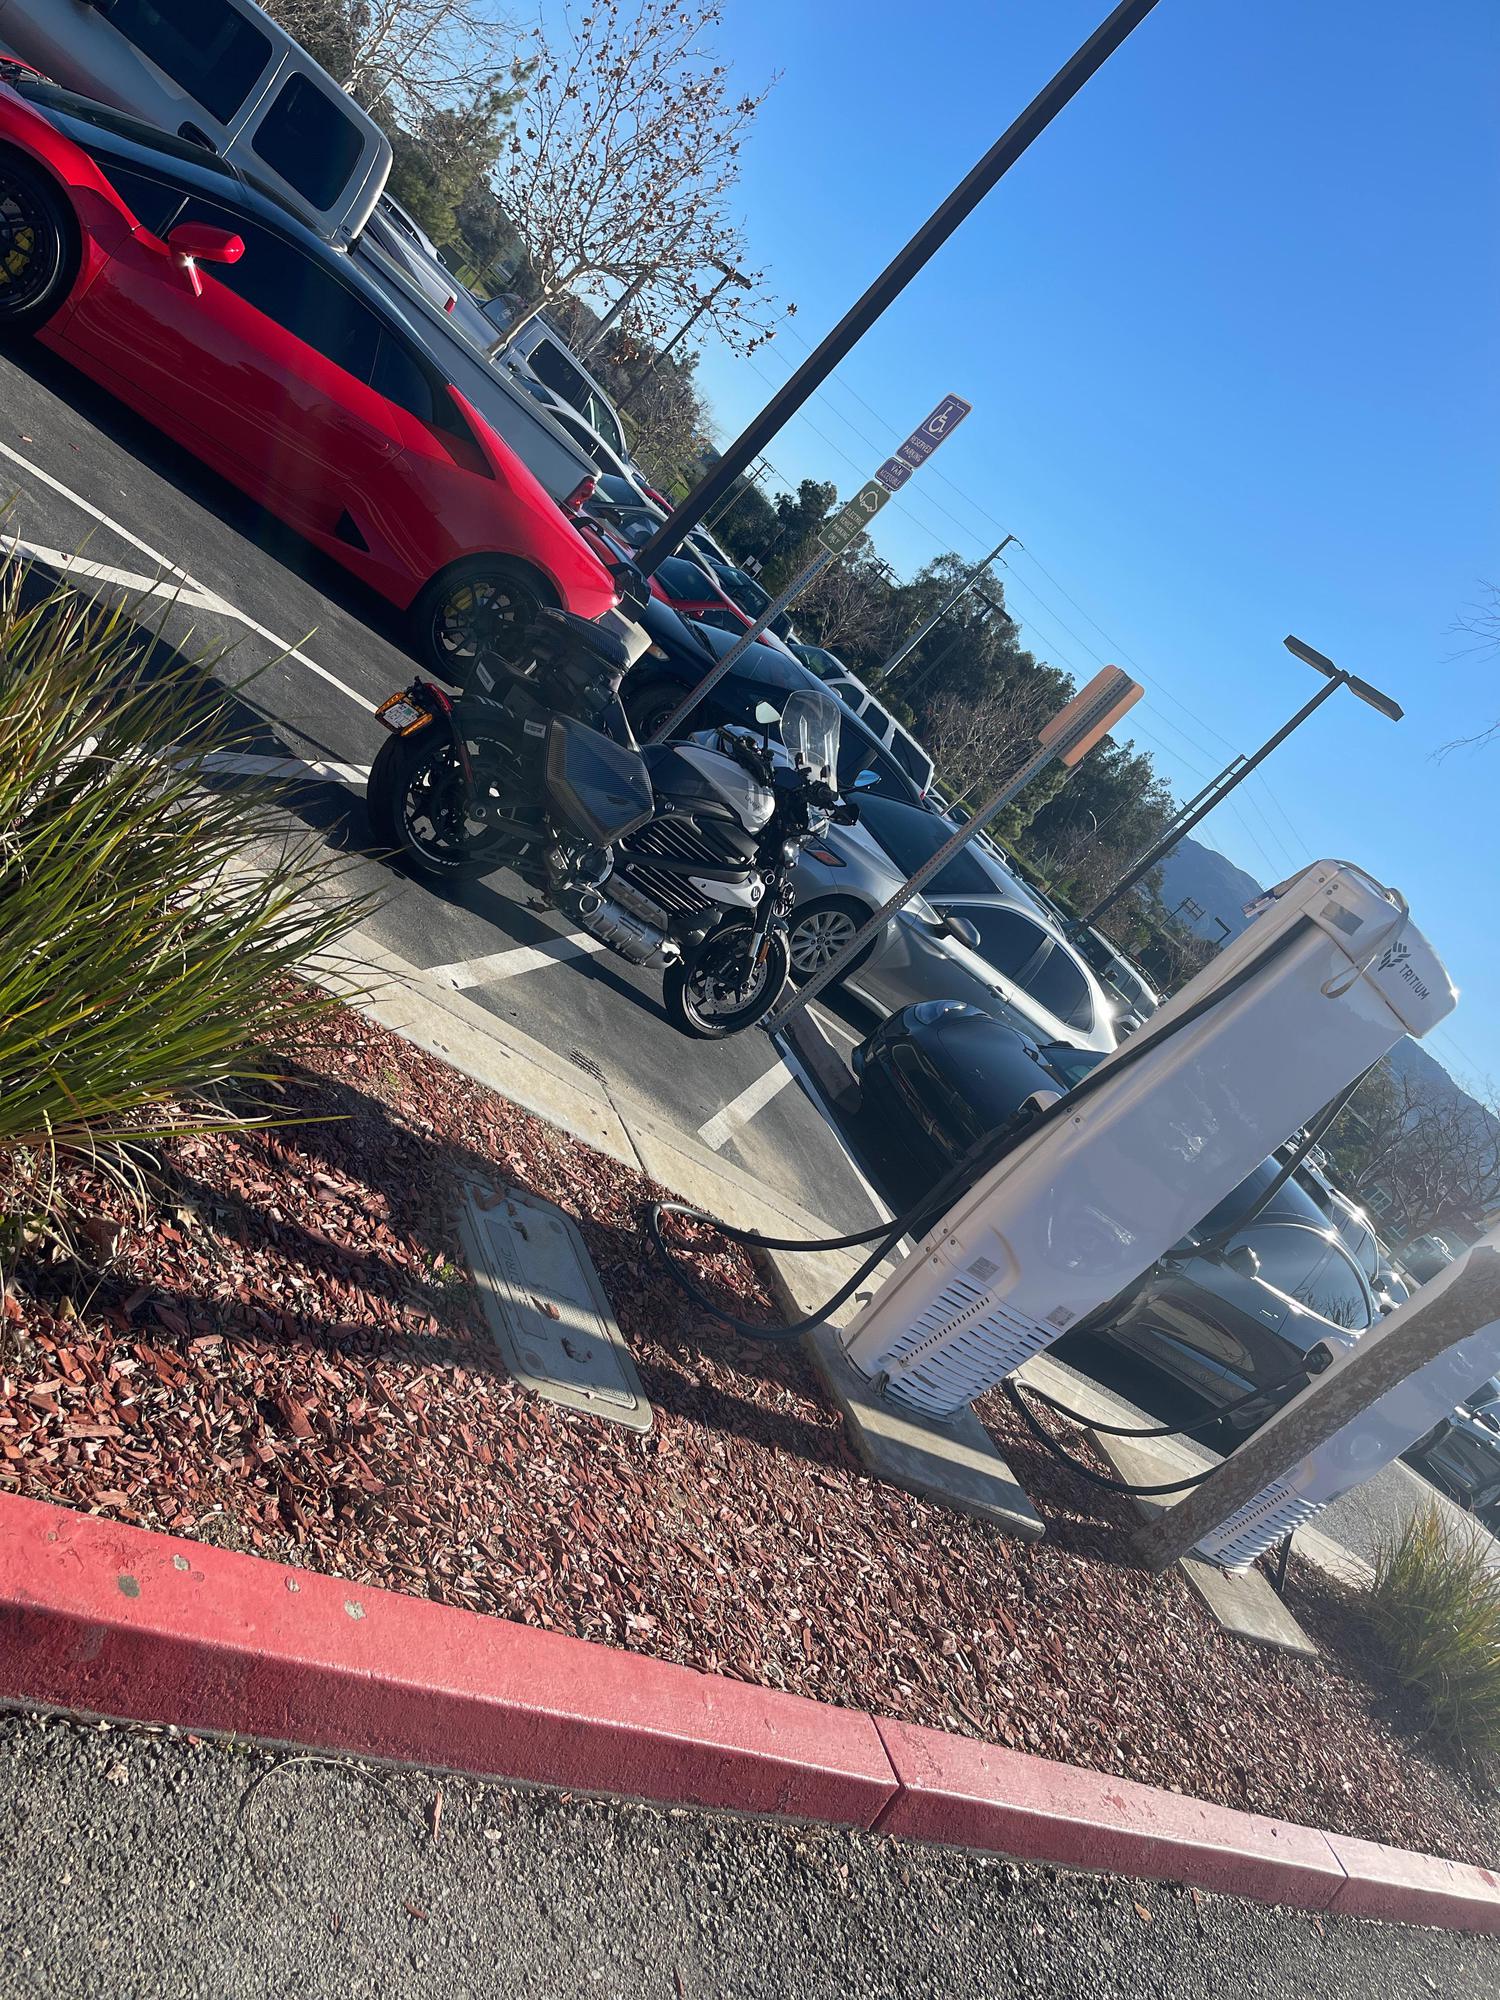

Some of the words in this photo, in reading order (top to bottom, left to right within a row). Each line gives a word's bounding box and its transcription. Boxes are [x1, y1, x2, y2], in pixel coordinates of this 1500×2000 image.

[910, 435, 933, 454] RESERVED
[903, 445, 923, 462] PARKING
[891, 465, 903, 476] VAN
[839, 516, 857, 532] VEHICLE
[845, 508, 865, 526] ELECTRIC
[833, 523, 851, 540] PARKING
[1399, 963, 1430, 1000] TRITIUM
[501, 1247, 531, 1308] ELECTRIC
